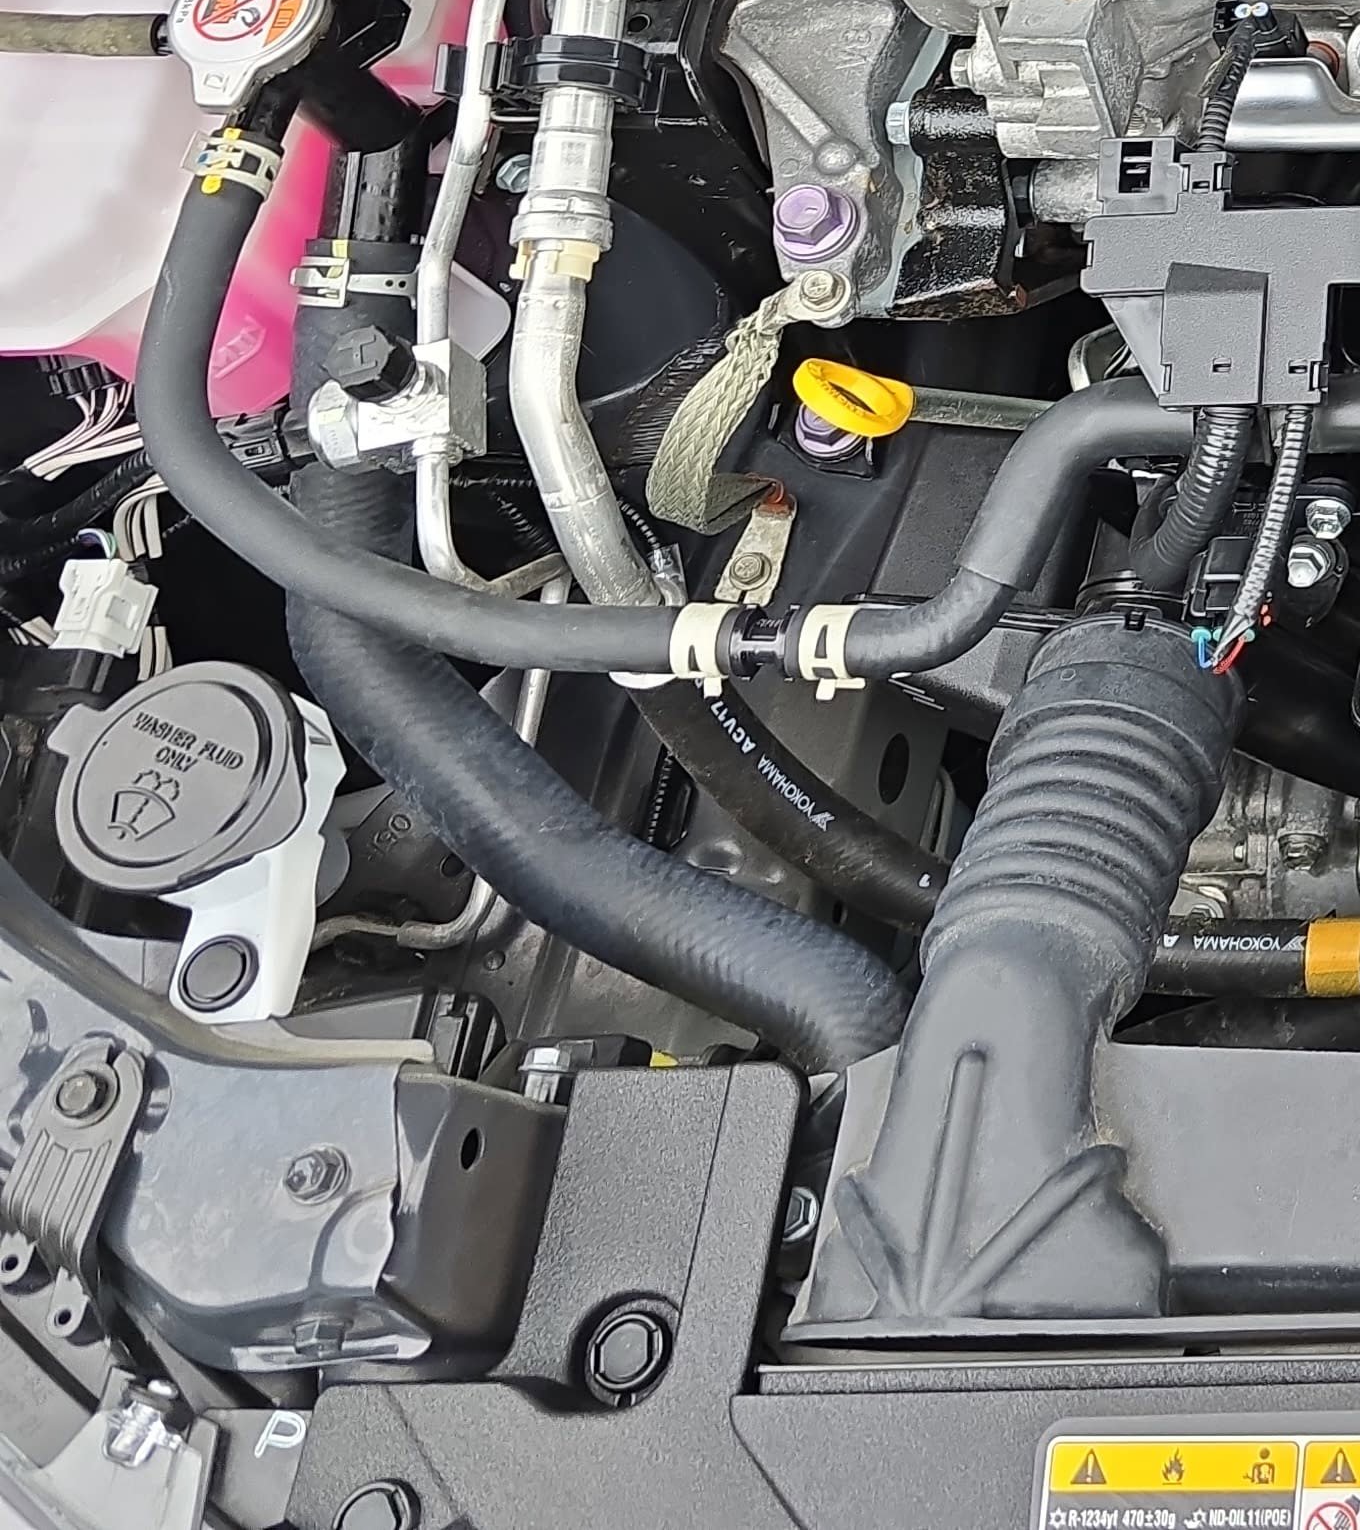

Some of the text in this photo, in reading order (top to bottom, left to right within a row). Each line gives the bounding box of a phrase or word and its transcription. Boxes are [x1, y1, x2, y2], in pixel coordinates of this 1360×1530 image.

[133, 712, 245, 770] WASHER FLUID
[155, 746, 199, 772] ONLY
[711, 701, 816, 818] YOKOHAMA ACV17
[1193, 935, 1281, 951] YOKOHAMA
[255, 1410, 306, 1458] P
[1068, 1508, 1292, 1529] R-1234yf 470±30g ND-OIL11(POE)
